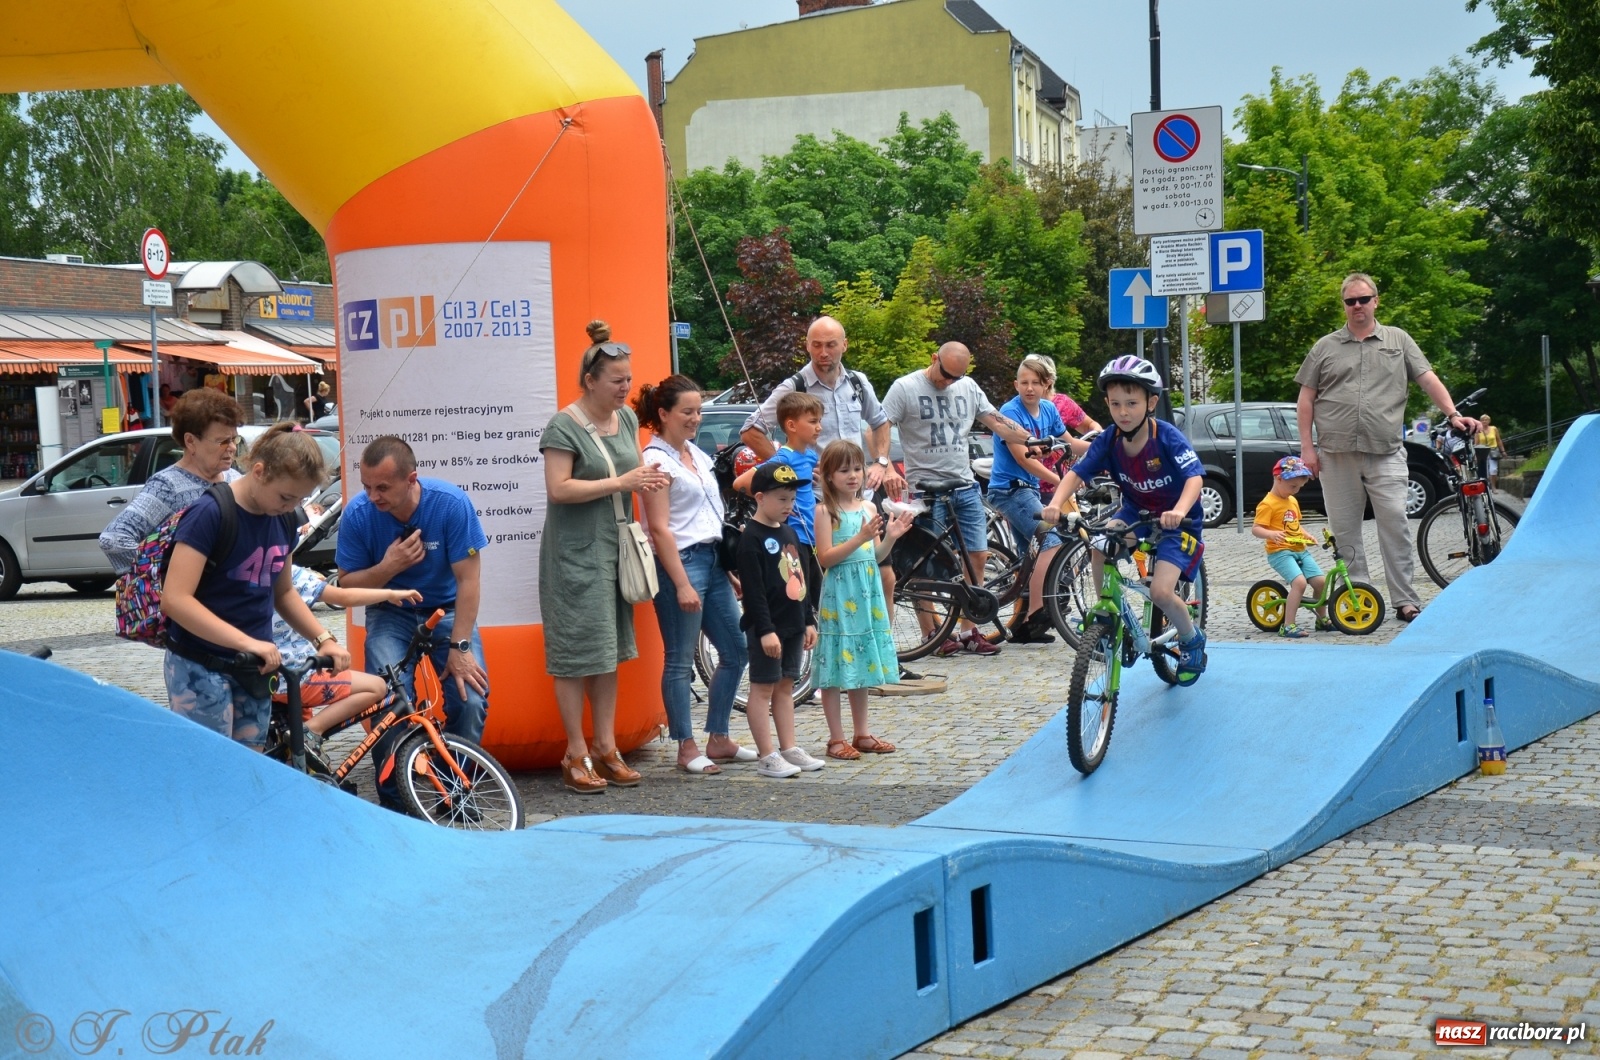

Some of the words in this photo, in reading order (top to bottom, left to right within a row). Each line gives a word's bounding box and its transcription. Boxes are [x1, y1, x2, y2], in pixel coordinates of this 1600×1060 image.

[1142, 167, 1165, 175] Postój
[1168, 164, 1212, 174] ograniczony
[1158, 176, 1178, 184] godz.
[1206, 172, 1216, 180] pt.
[1150, 184, 1171, 194] godz.
[1165, 192, 1191, 200] sobota
[1150, 202, 1170, 211] godz.
[1174, 198, 1214, 208] 9.00-13.00
[148, 248, 164, 261] 8-12
[1218, 238, 1250, 284] P
[360, 409, 384, 420] Projekt
[386, 410, 391, 418] o
[392, 408, 432, 418] numerze
[434, 404, 514, 417] rejestracyjnym
[432, 432, 448, 443] pn:
[484, 430, 503, 439] bez
[451, 456, 474, 466] 85%
[491, 454, 539, 465] środków
[472, 481, 519, 492] Rozwoju
[486, 506, 533, 516] środków
